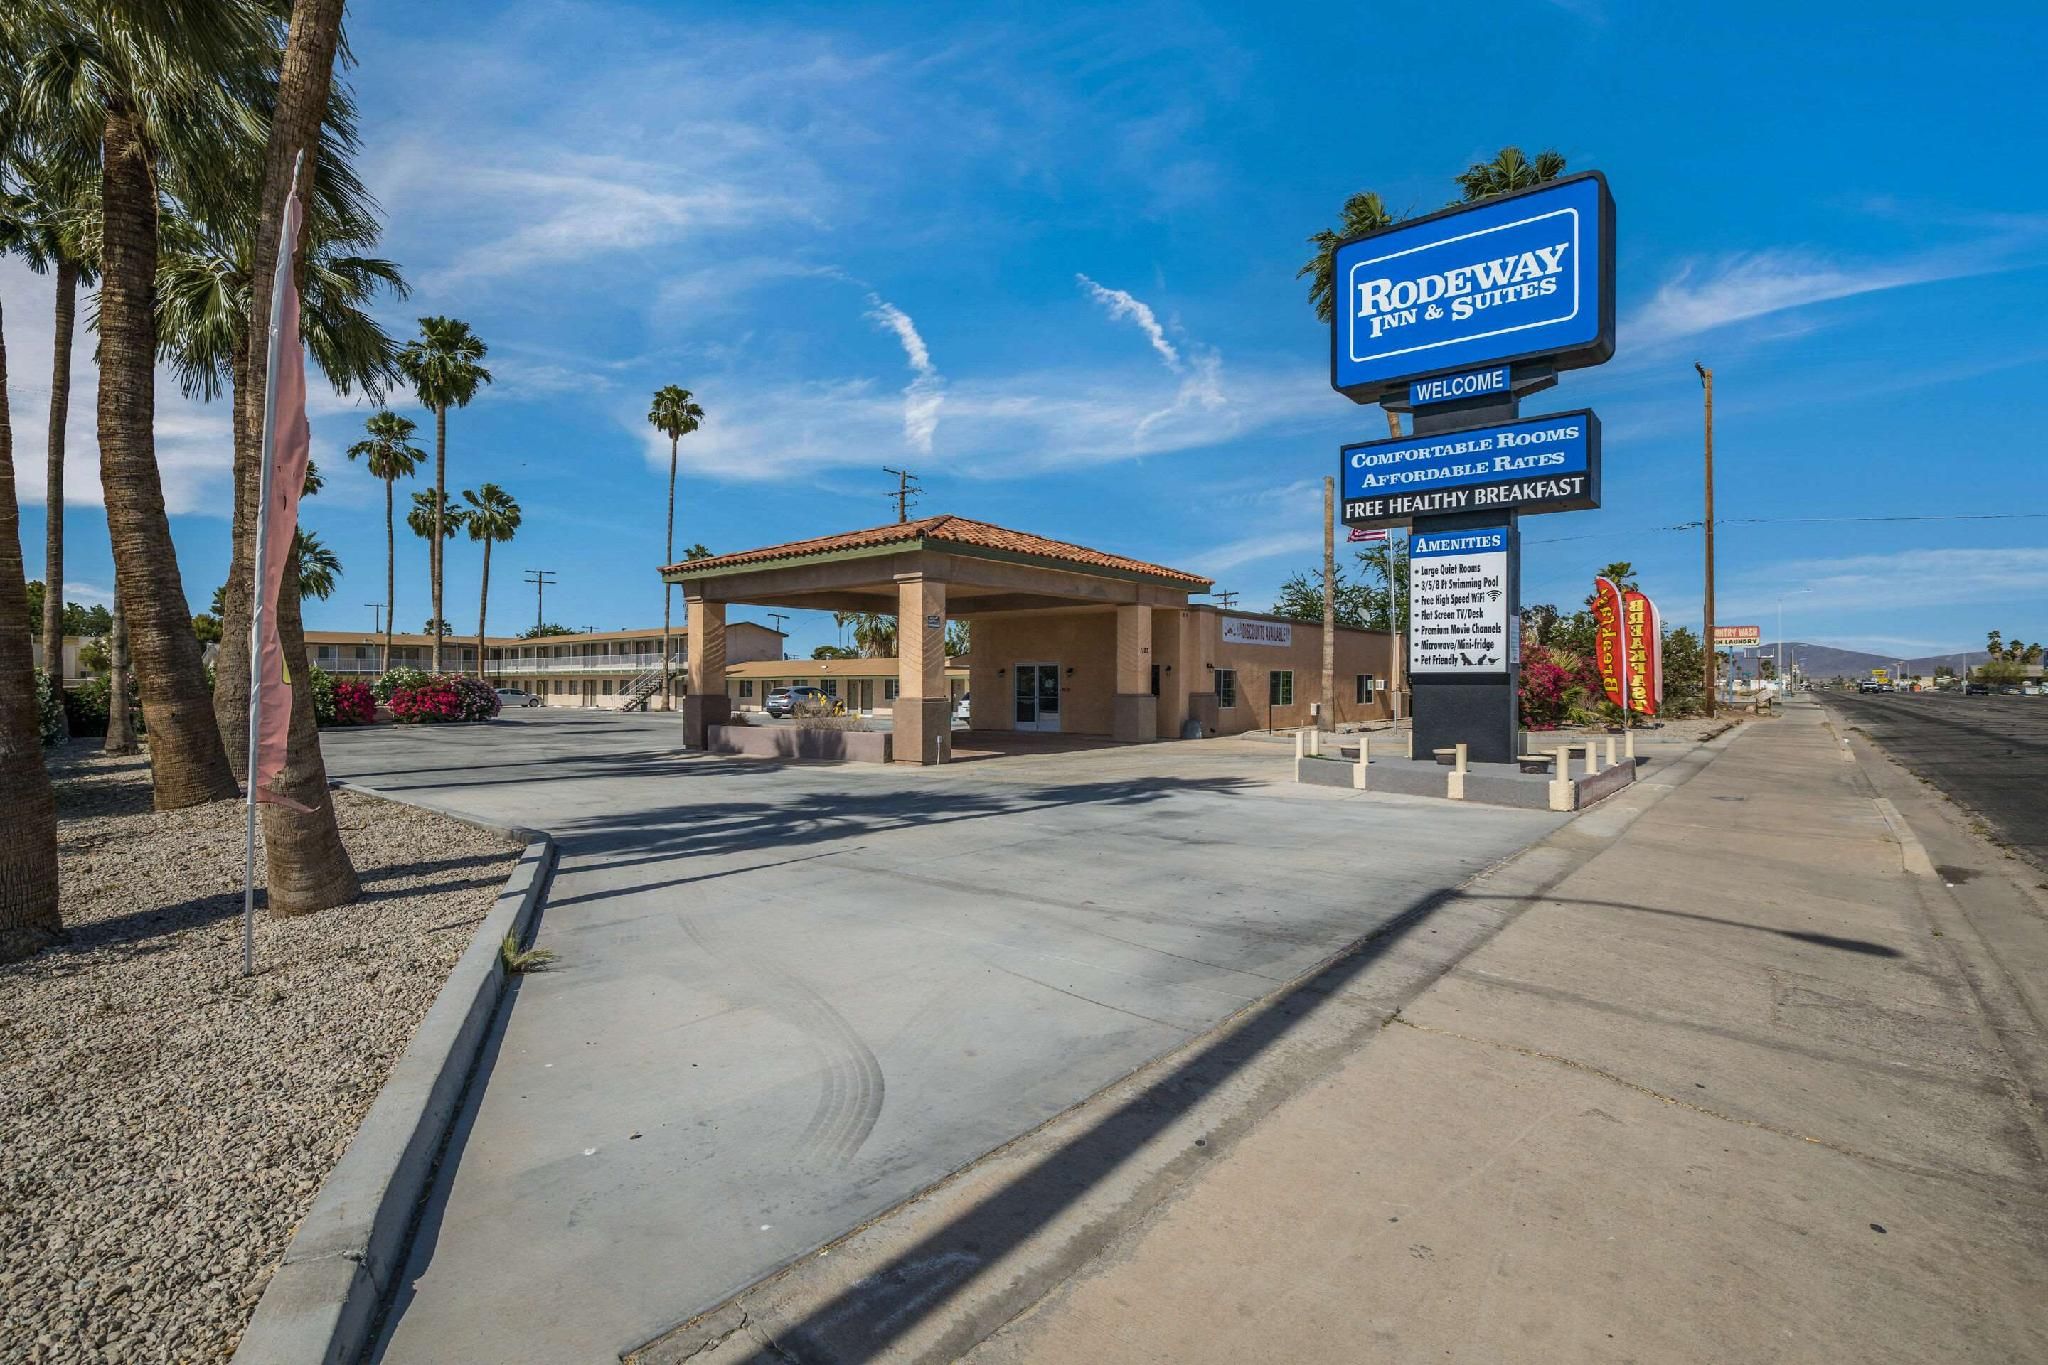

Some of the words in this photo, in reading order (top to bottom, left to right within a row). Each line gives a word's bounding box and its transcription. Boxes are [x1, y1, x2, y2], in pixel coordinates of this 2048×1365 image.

[1358, 242, 1570, 317] RODEWAY
[1370, 308, 1418, 338] INN
[1424, 303, 1444, 320] &
[1452, 276, 1557, 321] SUITES
[1417, 370, 1503, 401] WELCOME
[1351, 438, 1492, 469] COMFORTABLE
[1496, 426, 1579, 450] ROOMS
[1361, 461, 1489, 488] AFFORDABLE
[1493, 452, 1565, 472] RATES
[1345, 500, 1383, 519] FREE
[1389, 490, 1469, 514] HEALTHY
[1474, 477, 1585, 506] BREAKFAST
[1416, 534, 1501, 553] AMENITIES
[1421, 565, 1439, 577] Large
[1440, 563, 1457, 575] Quiet
[1459, 563, 1481, 573] Rooms
[1449, 577, 1482, 590] Swimming
[1483, 575, 1499, 587] Pool
[1421, 595, 1434, 606] Free
[1436, 594, 1450, 606] High
[1450, 592, 1470, 606] Speed
[1434, 609, 1455, 620] Screen
[1421, 624, 1449, 635] Premium
[1450, 622, 1470, 634] Movie
[1472, 622, 1502, 634] Channels
[1420, 654, 1431, 665] Pet
[1433, 653, 1458, 667] Friendly
